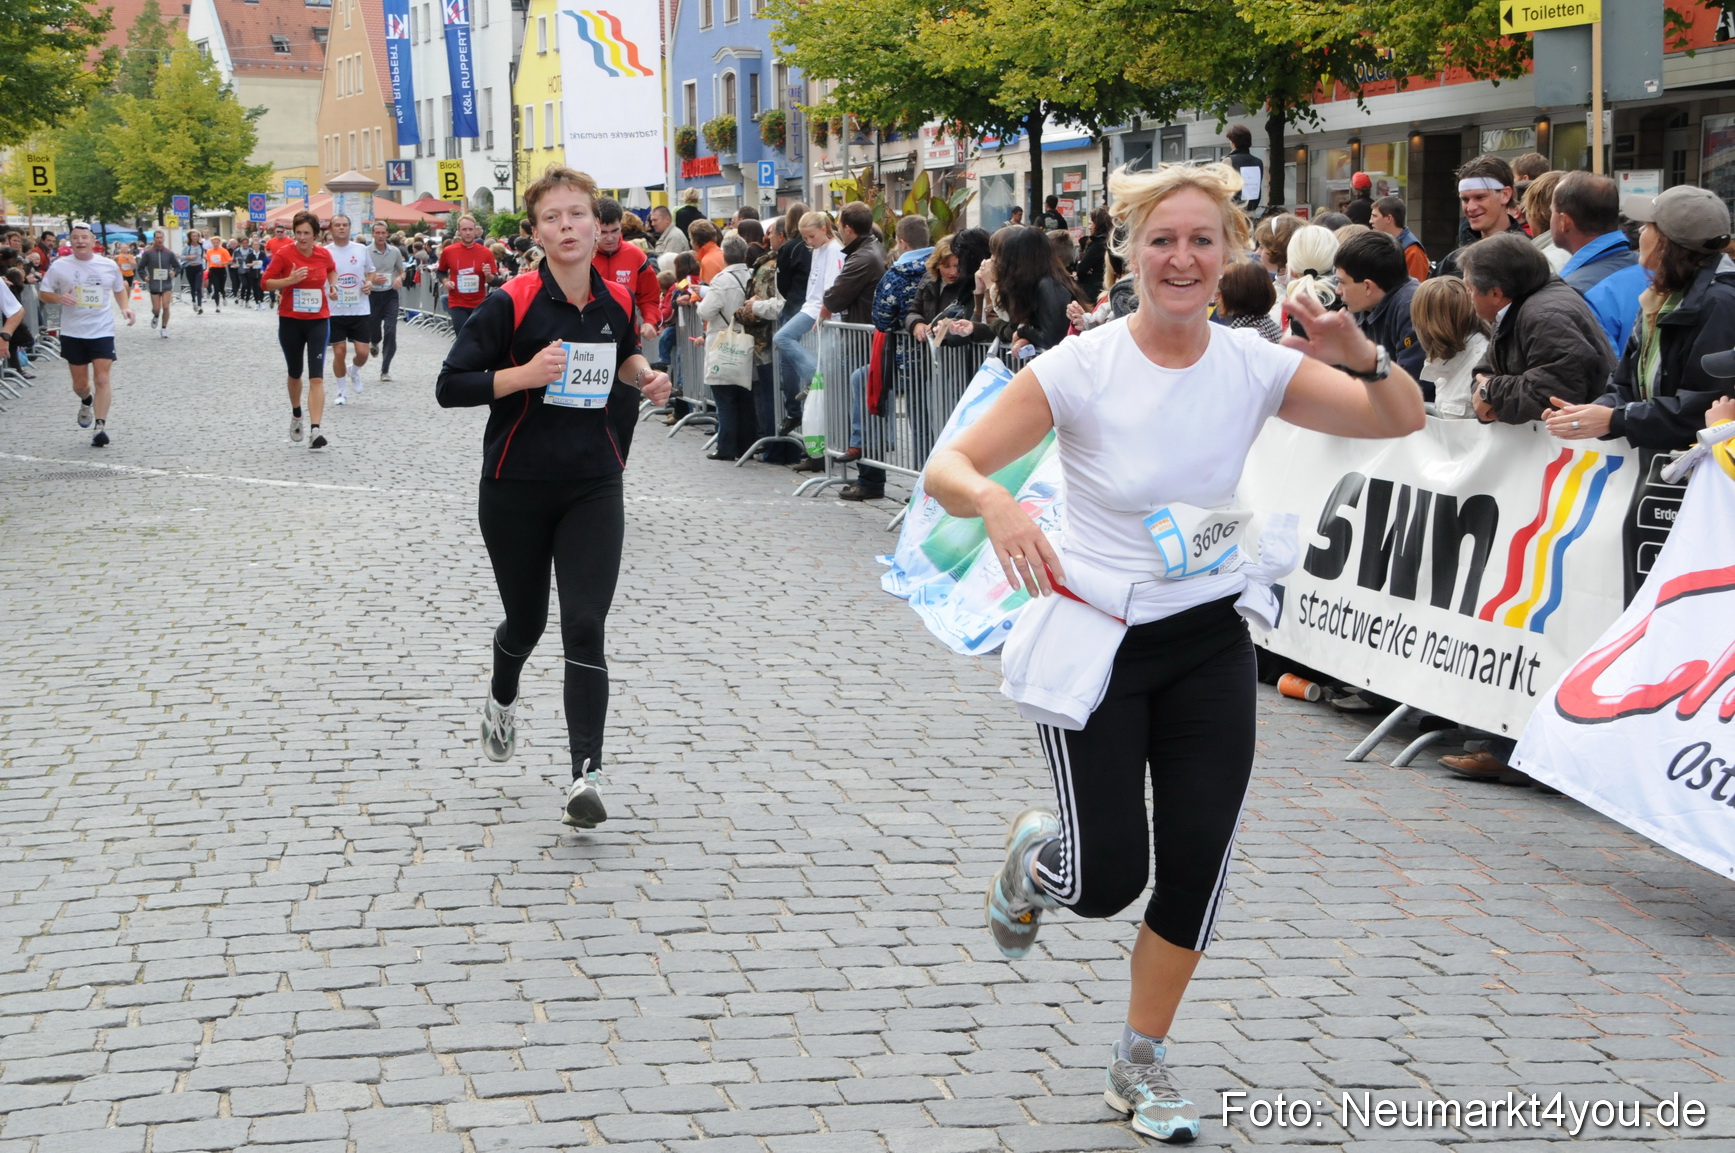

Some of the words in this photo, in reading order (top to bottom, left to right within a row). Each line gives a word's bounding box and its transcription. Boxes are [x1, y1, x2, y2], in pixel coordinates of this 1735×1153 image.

[1521, 4, 1584, 21] Toiletten
[458, 29, 471, 88] RUPPERT
[463, 91, 473, 114] K&L
[27, 154, 51, 163] Block
[440, 161, 461, 170] Block
[32, 166, 48, 186] B
[444, 172, 459, 191] B
[251, 212, 265, 220] TAXI
[85, 295, 99, 303] 305
[573, 349, 594, 361] Anita
[571, 368, 610, 386] 2449
[1654, 507, 1678, 522] Erdg
[1192, 520, 1240, 558] 3606
[1303, 471, 1500, 618] swn
[1298, 590, 1418, 660] stadtwerke
[1419, 628, 1541, 698] neumarkt
[1666, 741, 1735, 810] Ost
